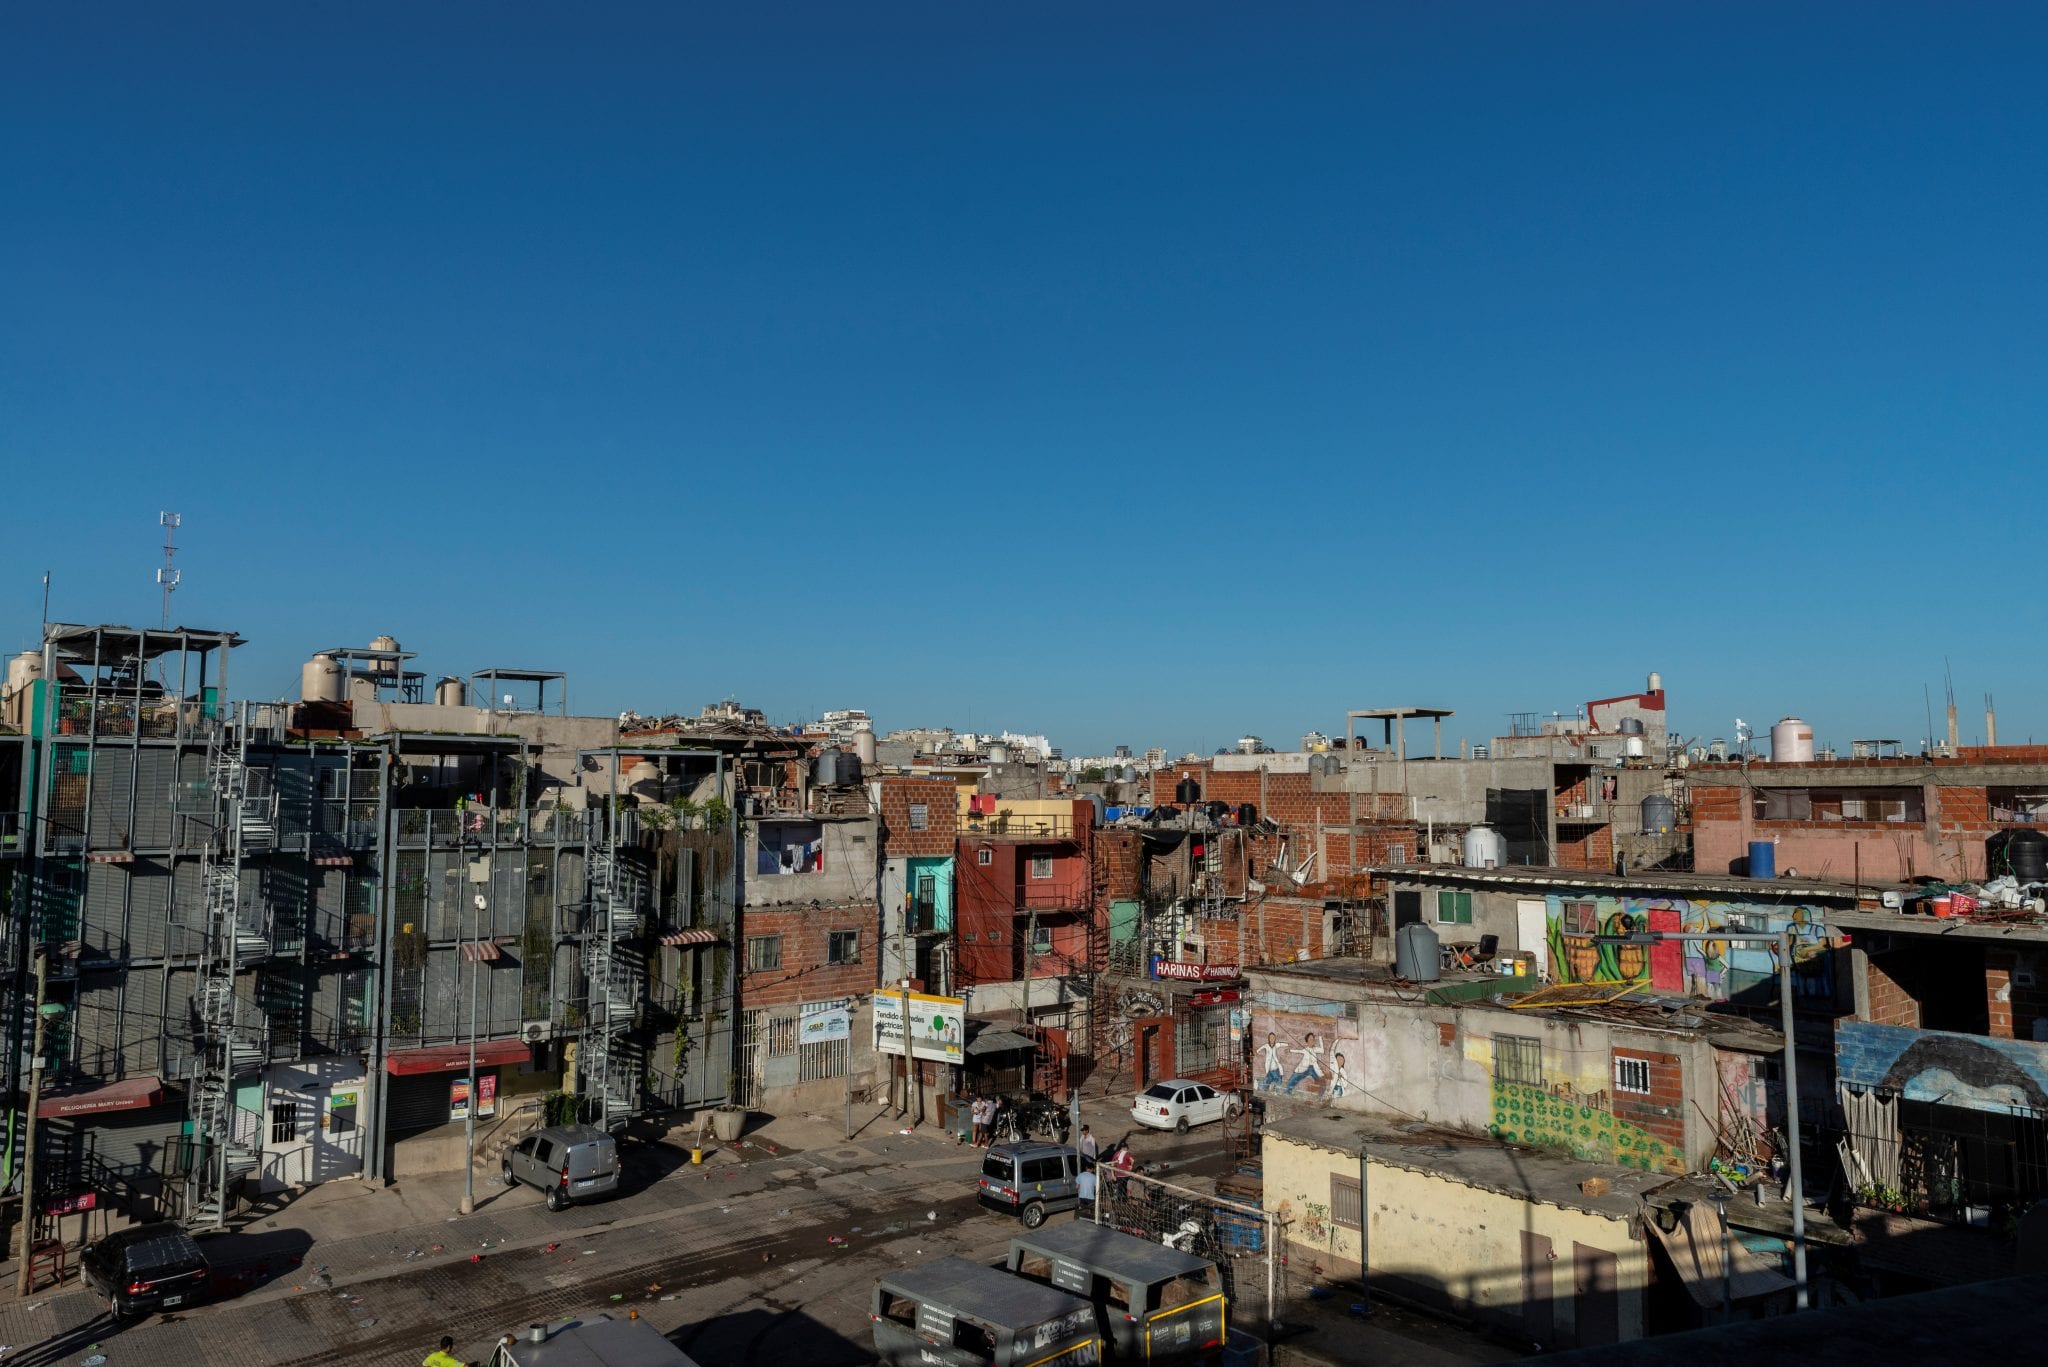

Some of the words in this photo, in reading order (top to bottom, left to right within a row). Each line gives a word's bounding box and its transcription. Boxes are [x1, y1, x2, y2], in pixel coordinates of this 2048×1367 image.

[1156, 962, 1200, 978] HARINAS
[876, 1010, 899, 1020] Tendido
[877, 1030, 894, 1038] edia
